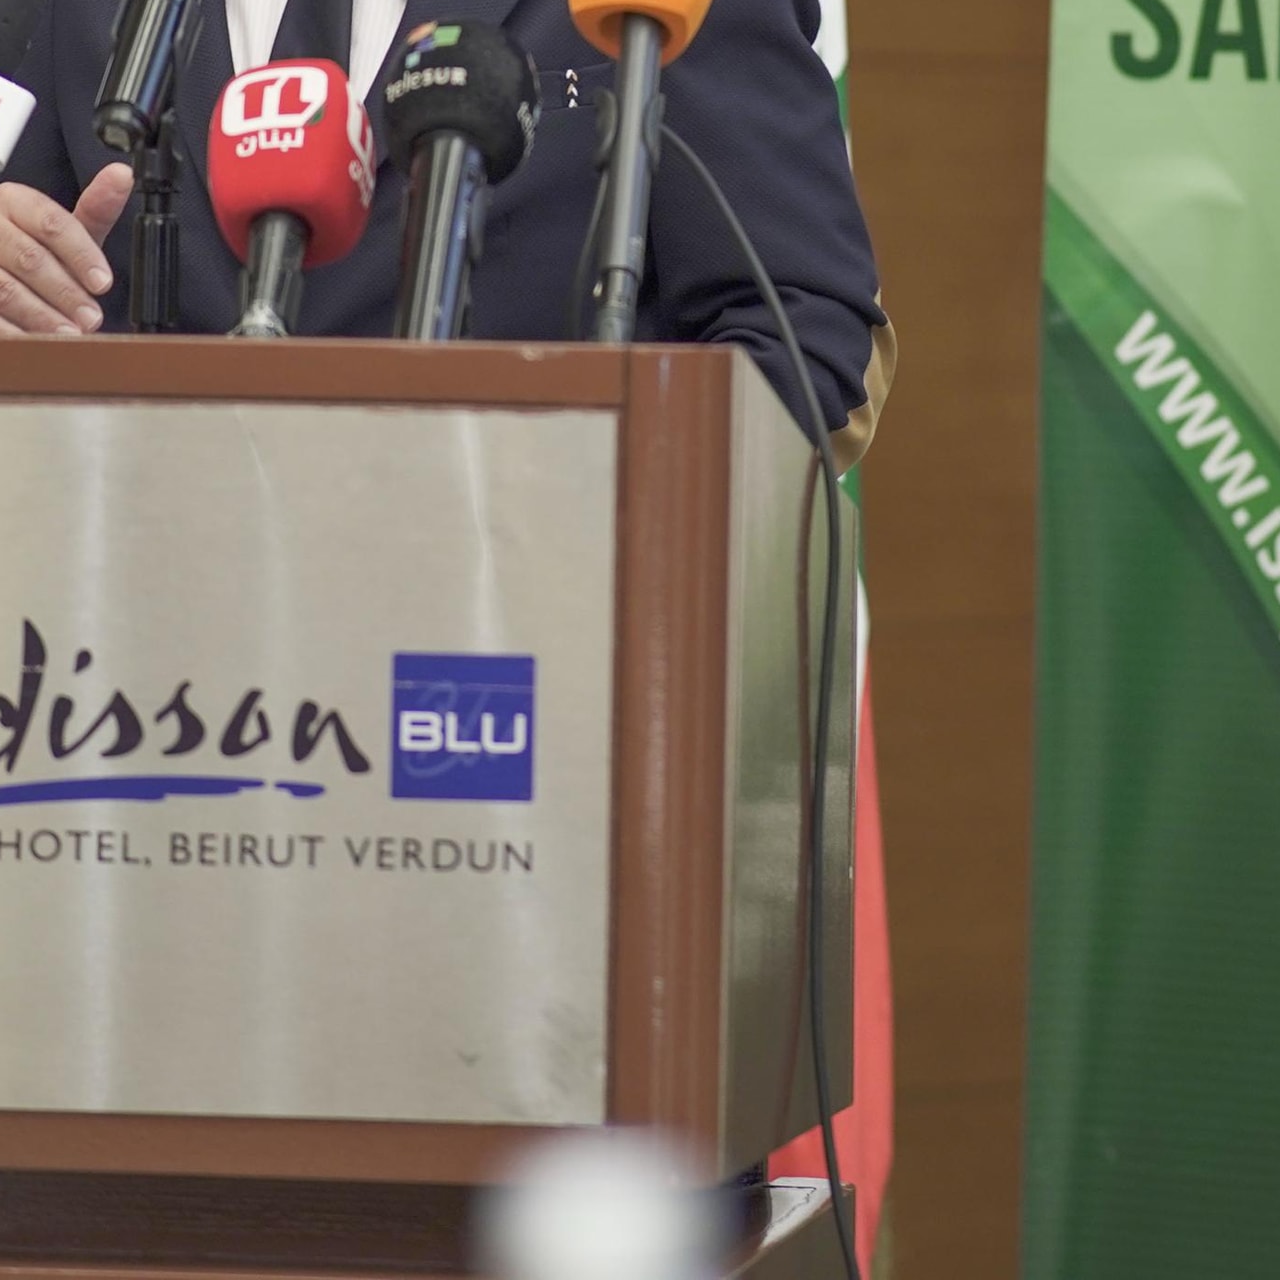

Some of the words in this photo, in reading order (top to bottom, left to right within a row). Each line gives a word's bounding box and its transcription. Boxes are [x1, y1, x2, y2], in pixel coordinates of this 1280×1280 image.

[399, 710, 528, 755] BLU
[168, 832, 324, 868] BEIRUT
[345, 836, 534, 873] VERDUN
